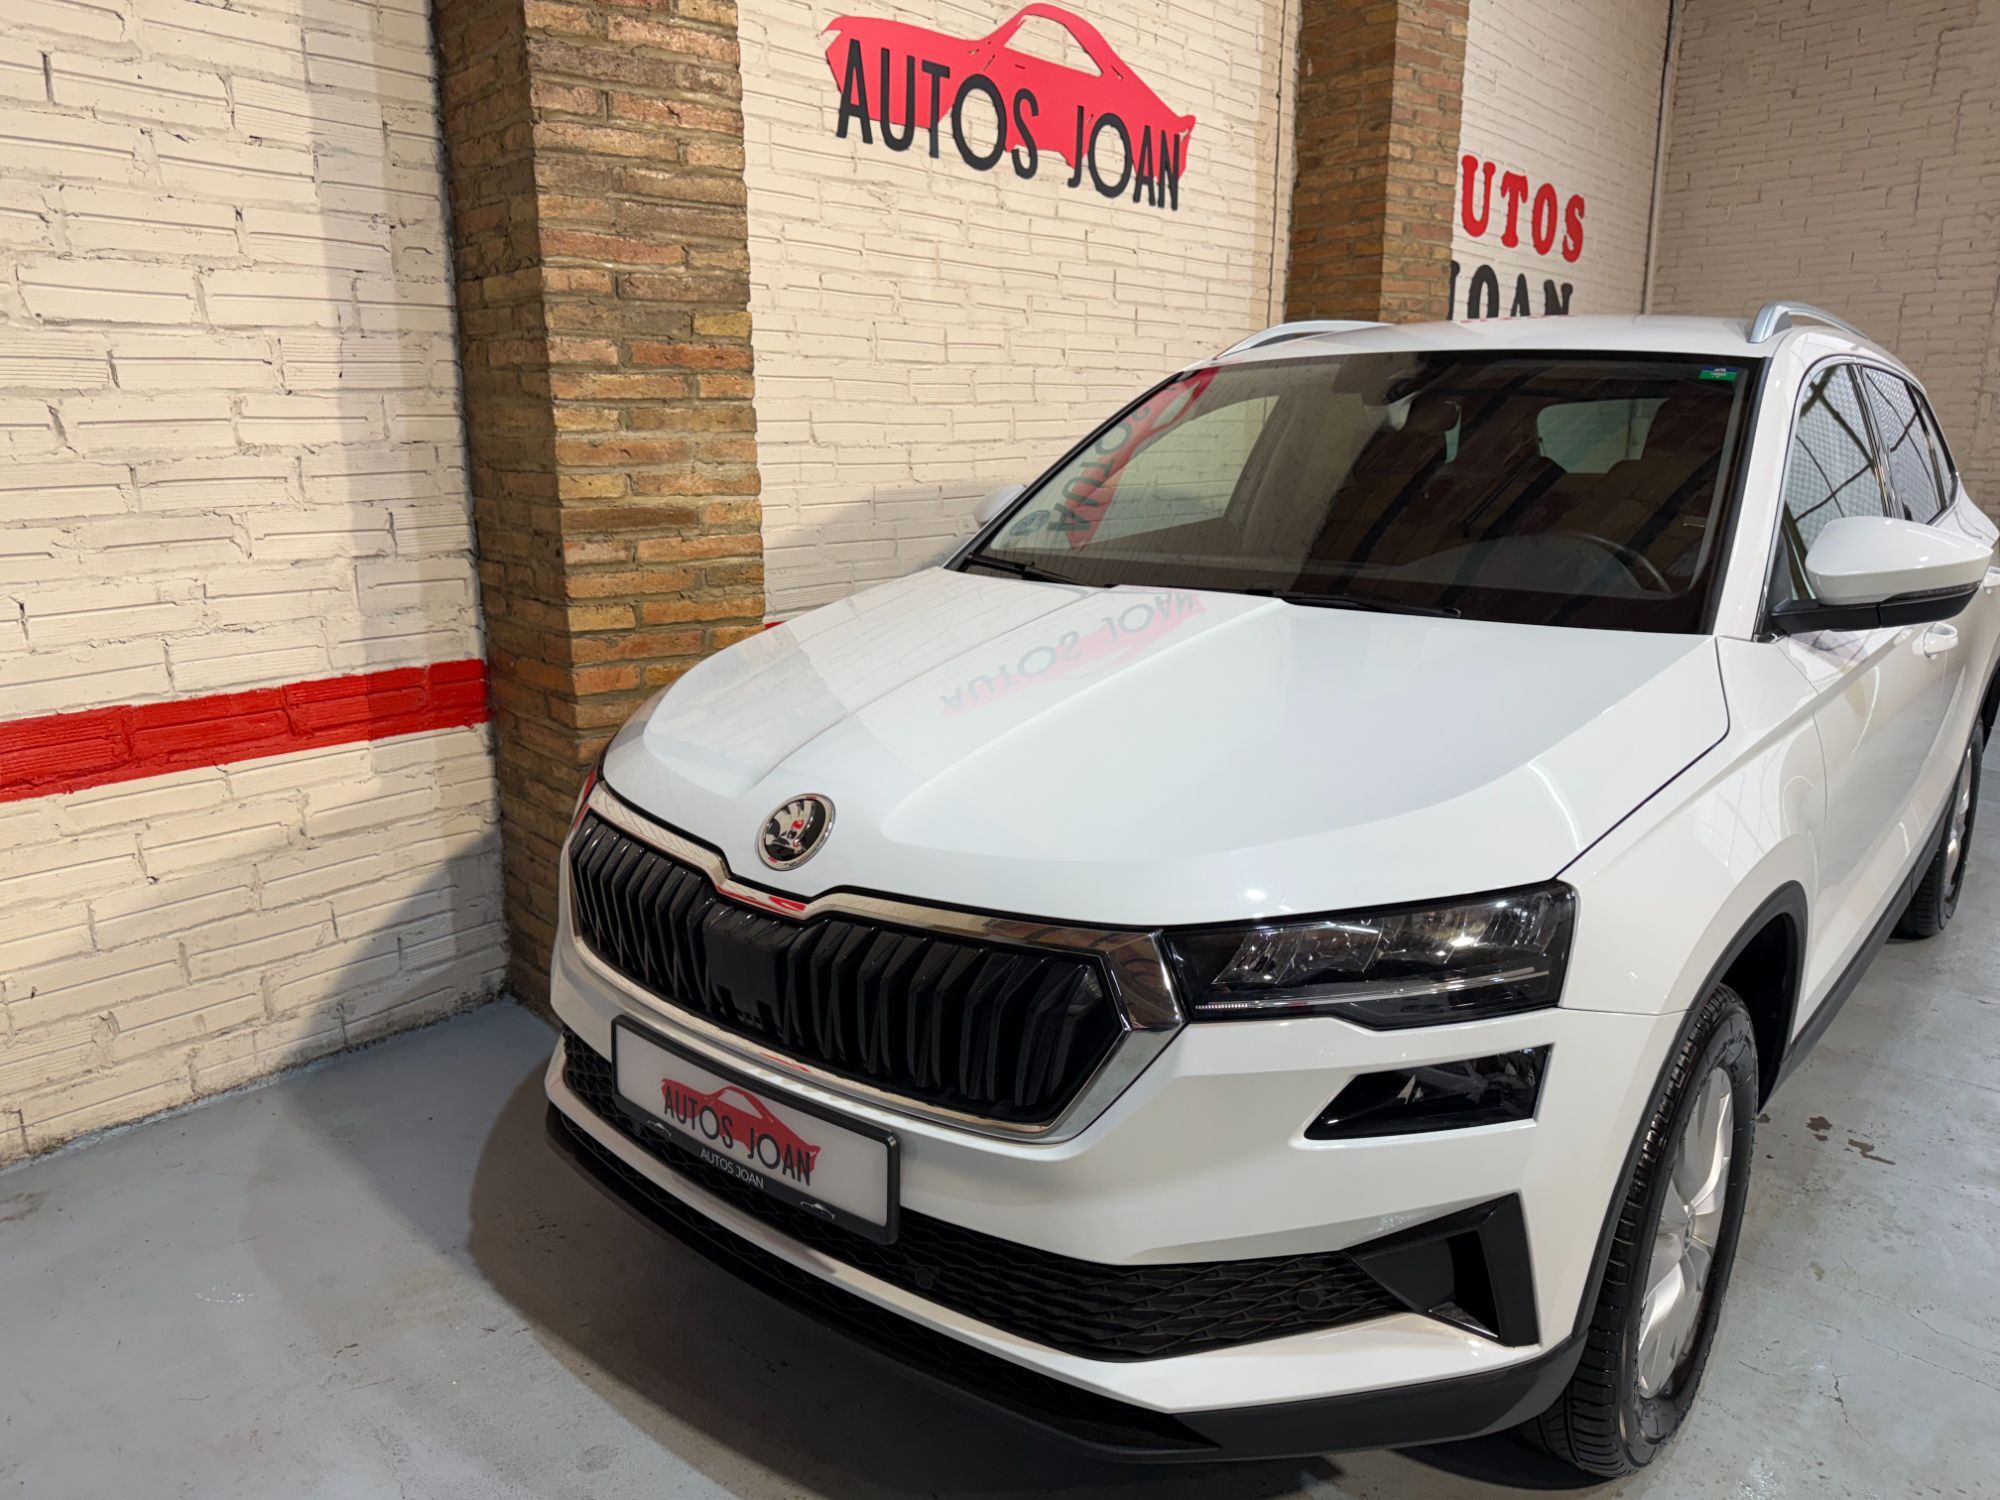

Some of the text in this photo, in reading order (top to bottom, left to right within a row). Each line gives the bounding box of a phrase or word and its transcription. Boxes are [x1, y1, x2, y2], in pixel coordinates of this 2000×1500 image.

[836, 38, 1180, 211] AUTOS JOAN
[1461, 154, 1585, 263] UTOS
[663, 1086, 811, 1187] AUTOS JOAN
[700, 1147, 764, 1190] AUTOS JOAN
